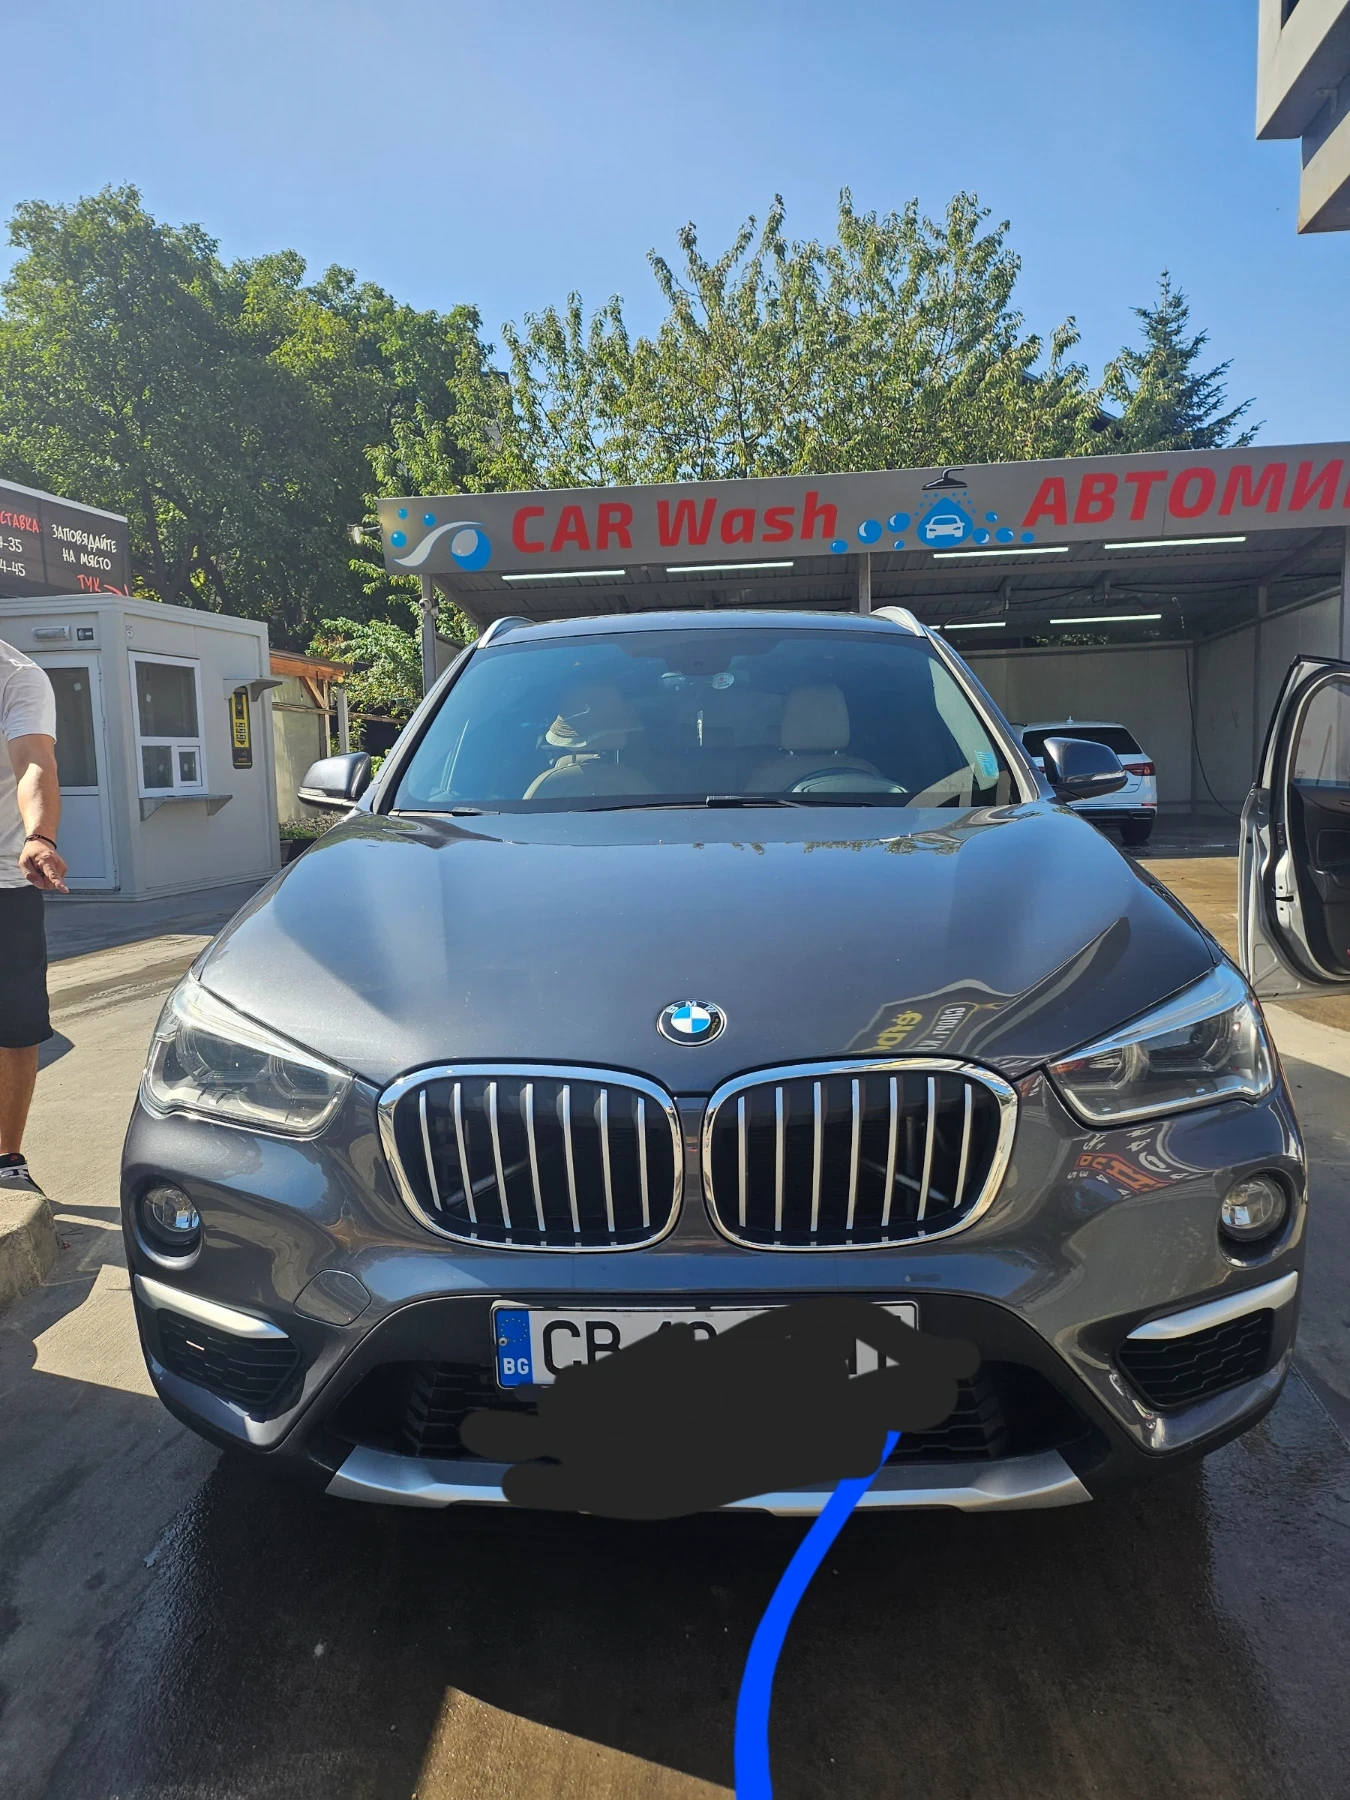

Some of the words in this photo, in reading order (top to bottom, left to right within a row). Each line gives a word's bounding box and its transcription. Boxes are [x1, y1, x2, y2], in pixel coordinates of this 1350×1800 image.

[1021, 459, 1350, 527] АВТОМИ
[512, 502, 634, 553] CAR
[656, 491, 839, 547] Wash
[51, 524, 117, 553] ЗАПОВЯДАЙТЕ
[62, 548, 76, 563] НА
[80, 552, 111, 570] МЯСТО
[77, 574, 101, 592] ТУК
[665, 1000, 718, 1014] BMW
[503, 1358, 529, 1375] BG
